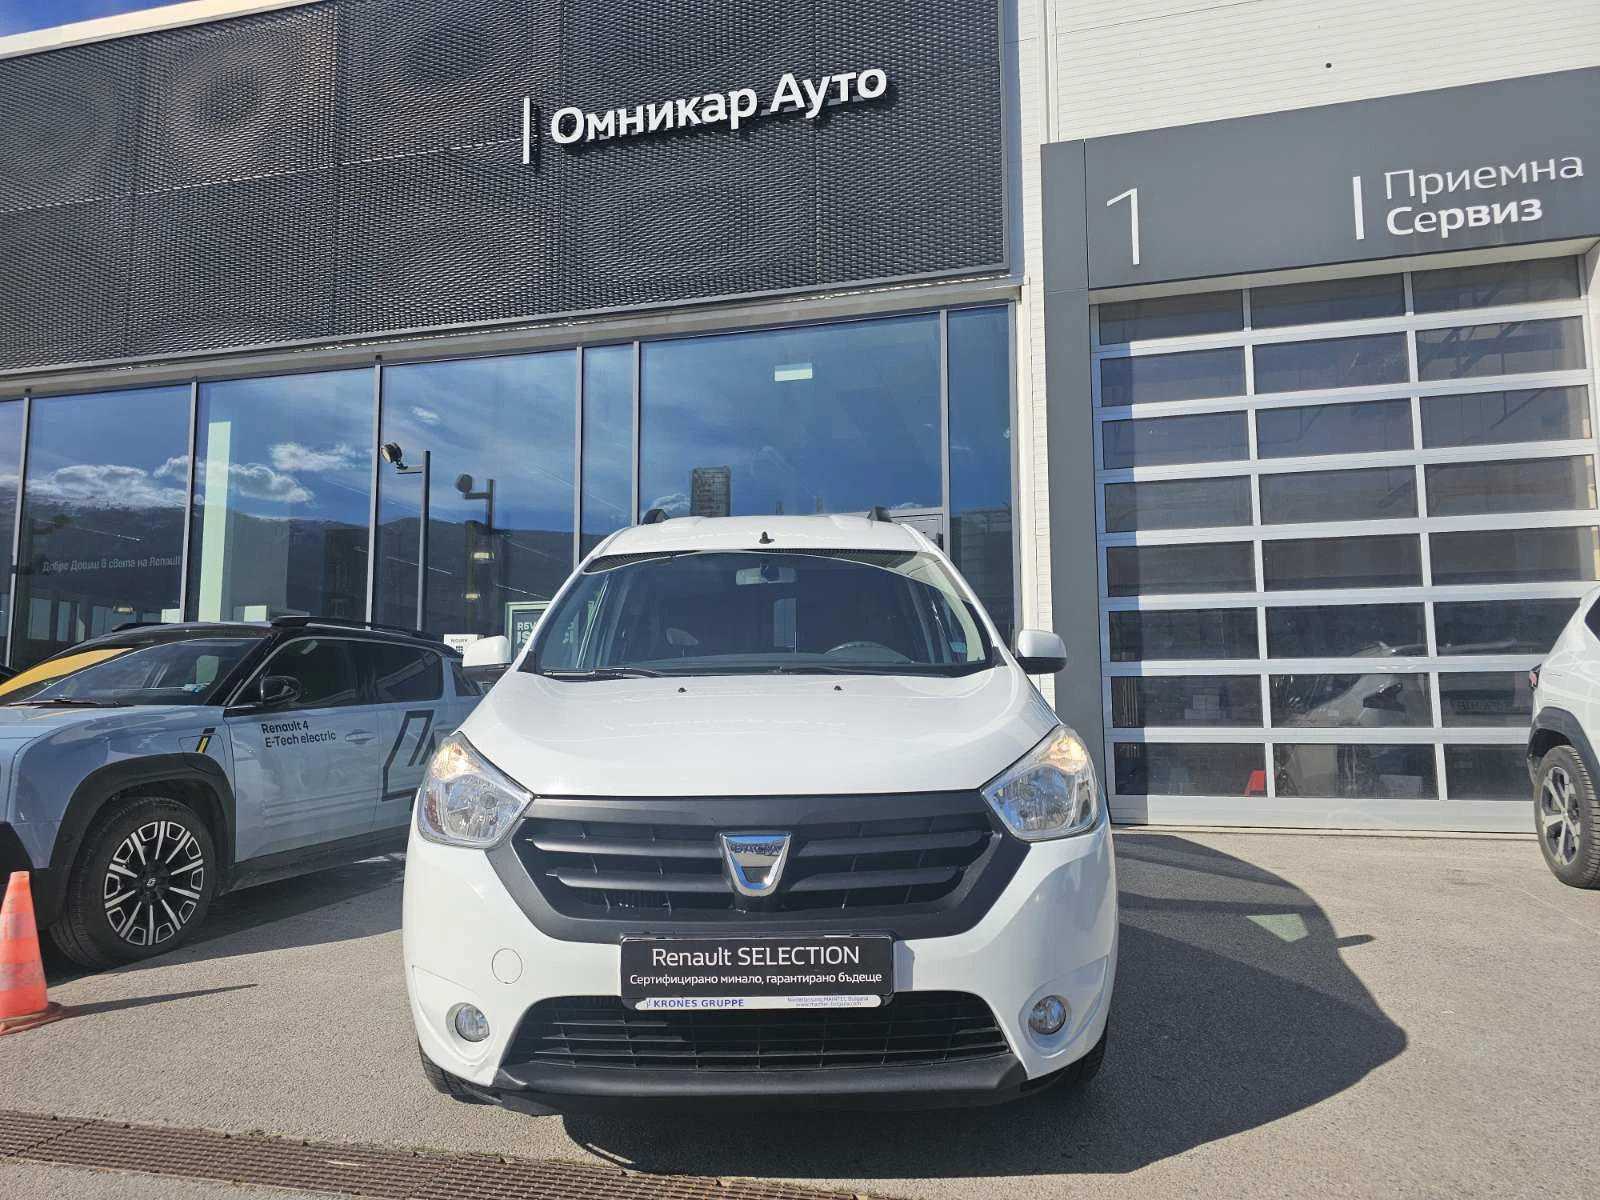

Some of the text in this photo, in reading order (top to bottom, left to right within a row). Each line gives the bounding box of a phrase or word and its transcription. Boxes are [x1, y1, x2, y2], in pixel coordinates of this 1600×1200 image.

[551, 68, 887, 144] Омникар Ауто
[1384, 156, 1584, 203] Приемна
[1106, 187, 1140, 265] 1
[1386, 198, 1543, 238] Сервиз
[261, 720, 309, 734] Renault 4
[265, 730, 337, 748] E-Tech electric
[652, 946, 860, 967] Renault SELECTION
[630, 972, 883, 987] Сертифицирано минало, гарантирано бъдеще
[653, 998, 745, 1008] KRONES GRUPPE
